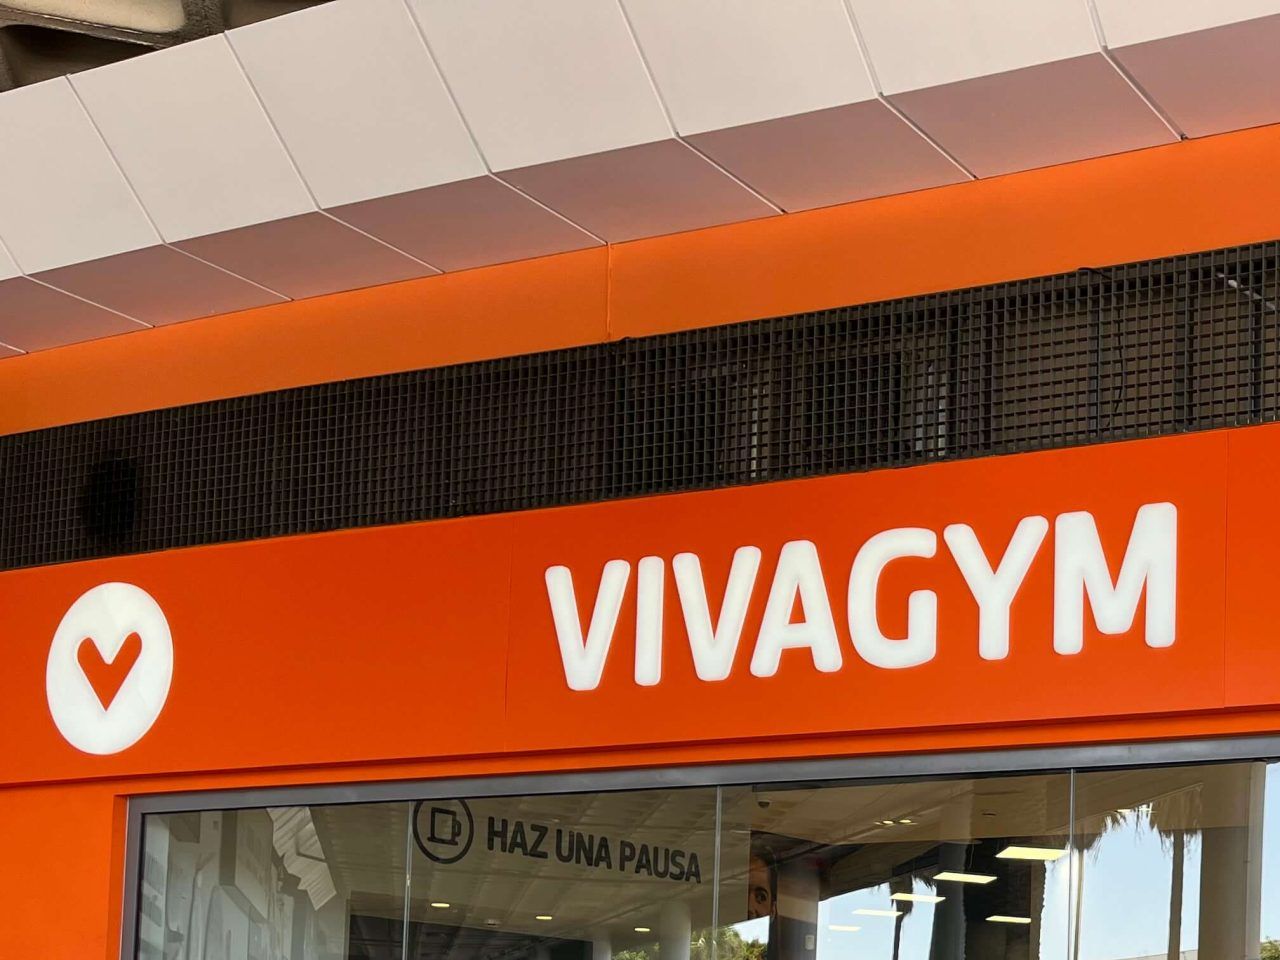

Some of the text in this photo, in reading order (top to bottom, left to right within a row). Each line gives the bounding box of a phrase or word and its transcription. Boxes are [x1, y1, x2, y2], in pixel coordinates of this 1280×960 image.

[545, 502, 1177, 691] VIVAGYM
[487, 816, 702, 884] HAZ UNA PAUSA
